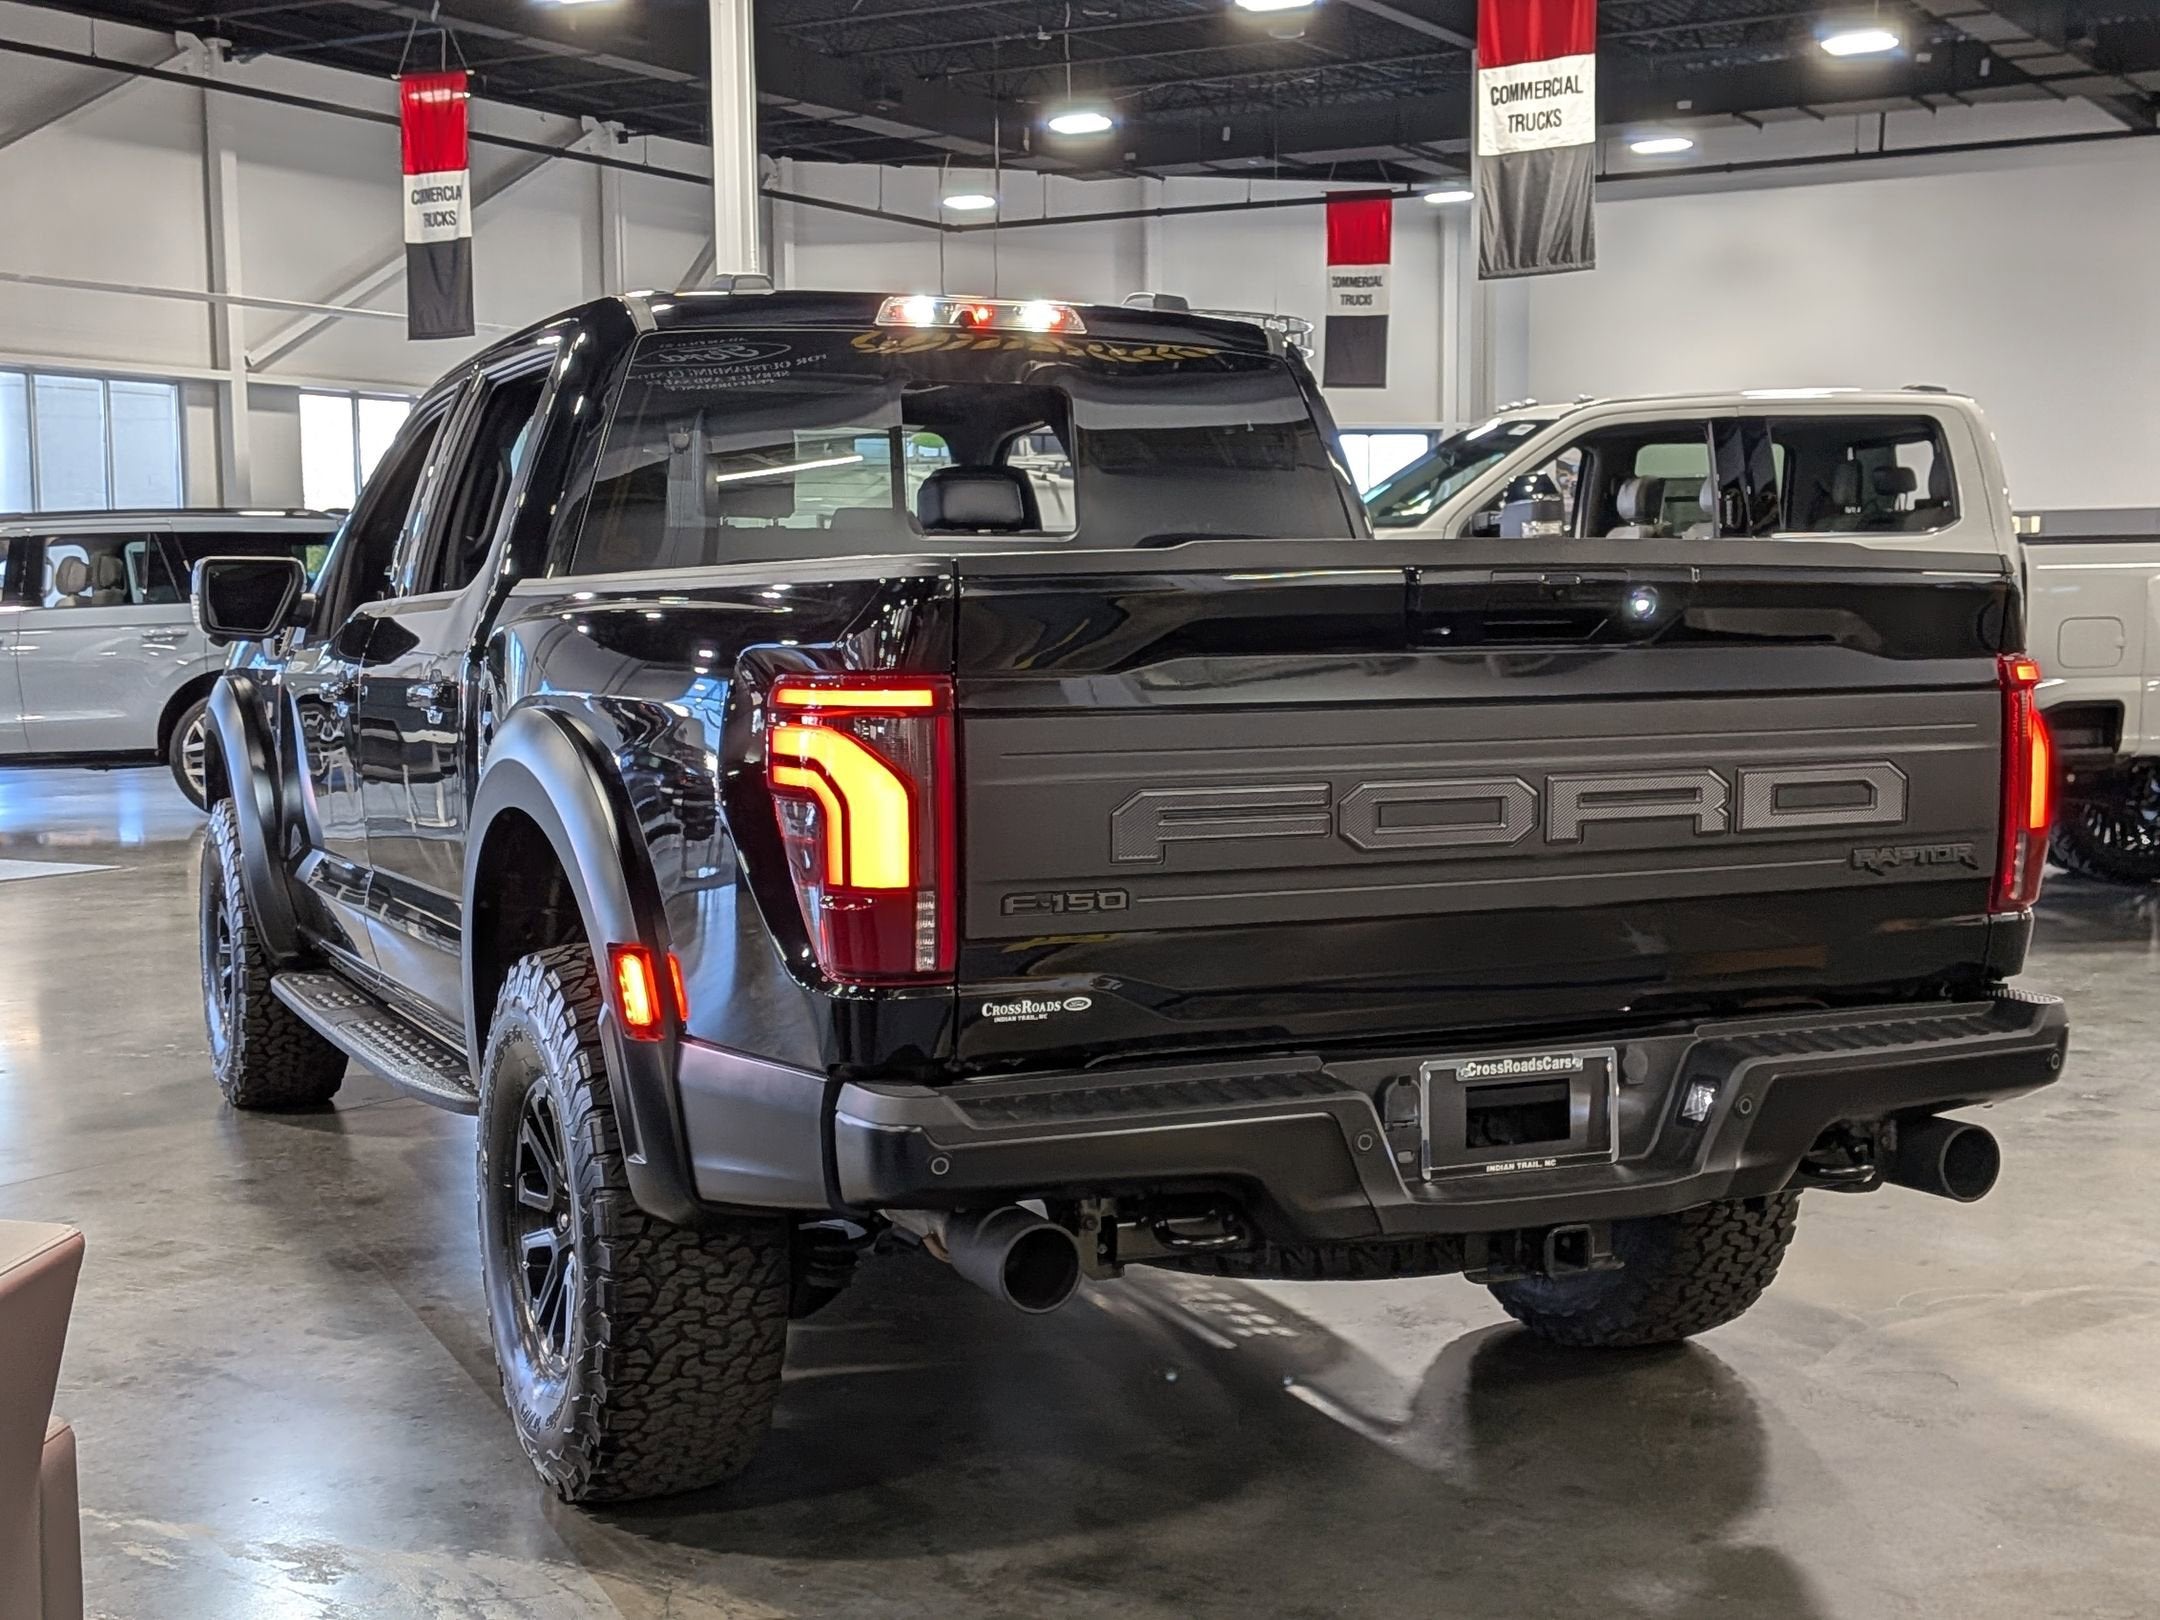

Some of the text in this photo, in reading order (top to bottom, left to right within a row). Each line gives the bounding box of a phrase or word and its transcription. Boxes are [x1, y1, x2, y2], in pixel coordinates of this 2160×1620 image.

[1490, 75, 1584, 106] COMMERCIAL
[1508, 108, 1562, 133] TRUCKS
[1111, 760, 1907, 864] FORD
[1852, 841, 1978, 876] RAPTOR
[1002, 887, 1129, 916] F-150
[1466, 1056, 1572, 1077] CrossRoadsCars
[1486, 1163, 1515, 1172] INDIAN
